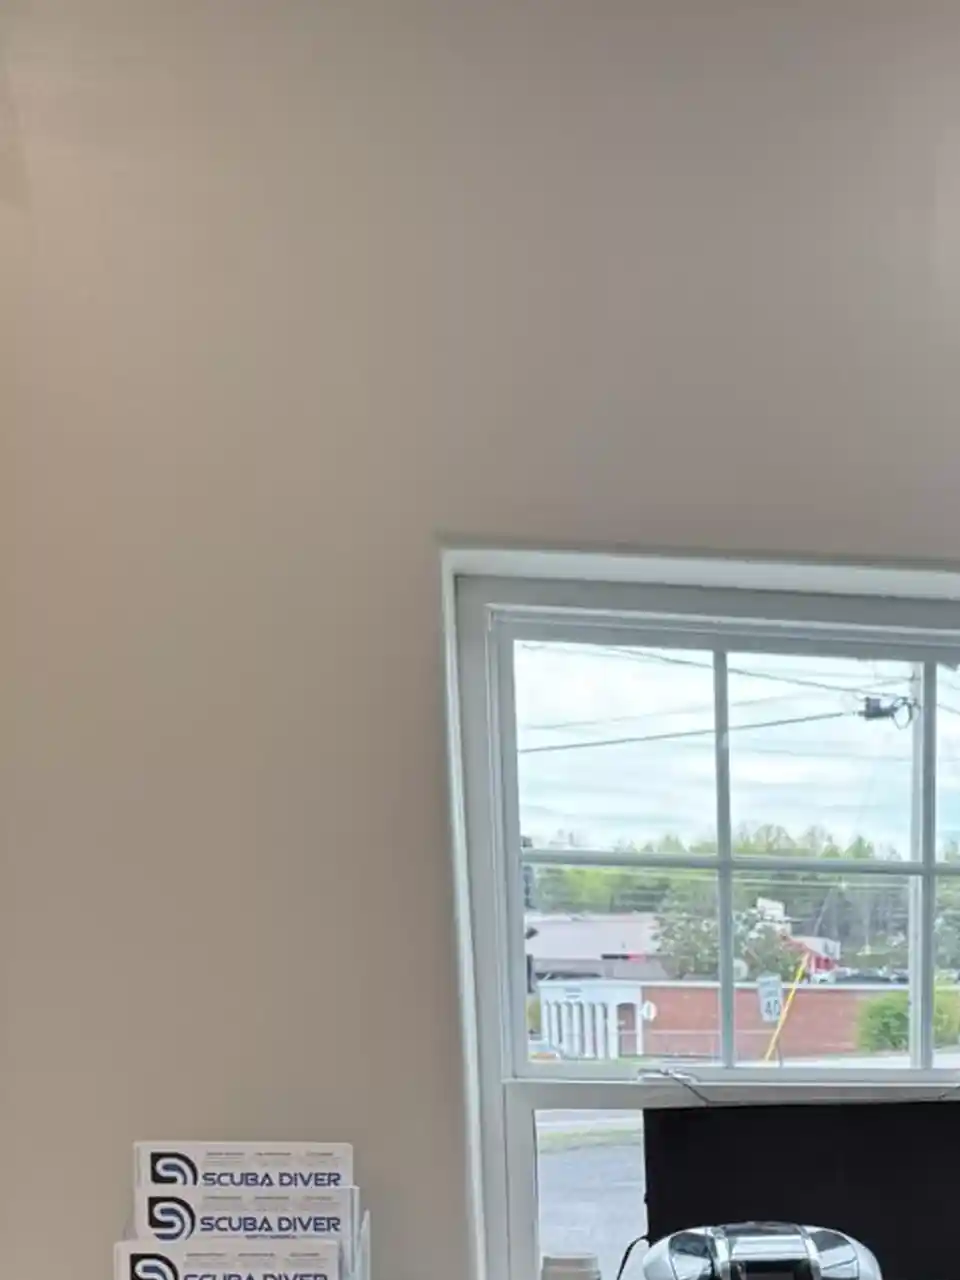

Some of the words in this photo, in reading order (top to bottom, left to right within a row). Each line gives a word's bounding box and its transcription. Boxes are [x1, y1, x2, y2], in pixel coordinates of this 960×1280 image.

[202, 1172, 275, 1187] SCUBA
[278, 1172, 341, 1187] DIVER
[199, 1216, 273, 1232] SCUBA
[277, 1216, 341, 1232] DIVER
